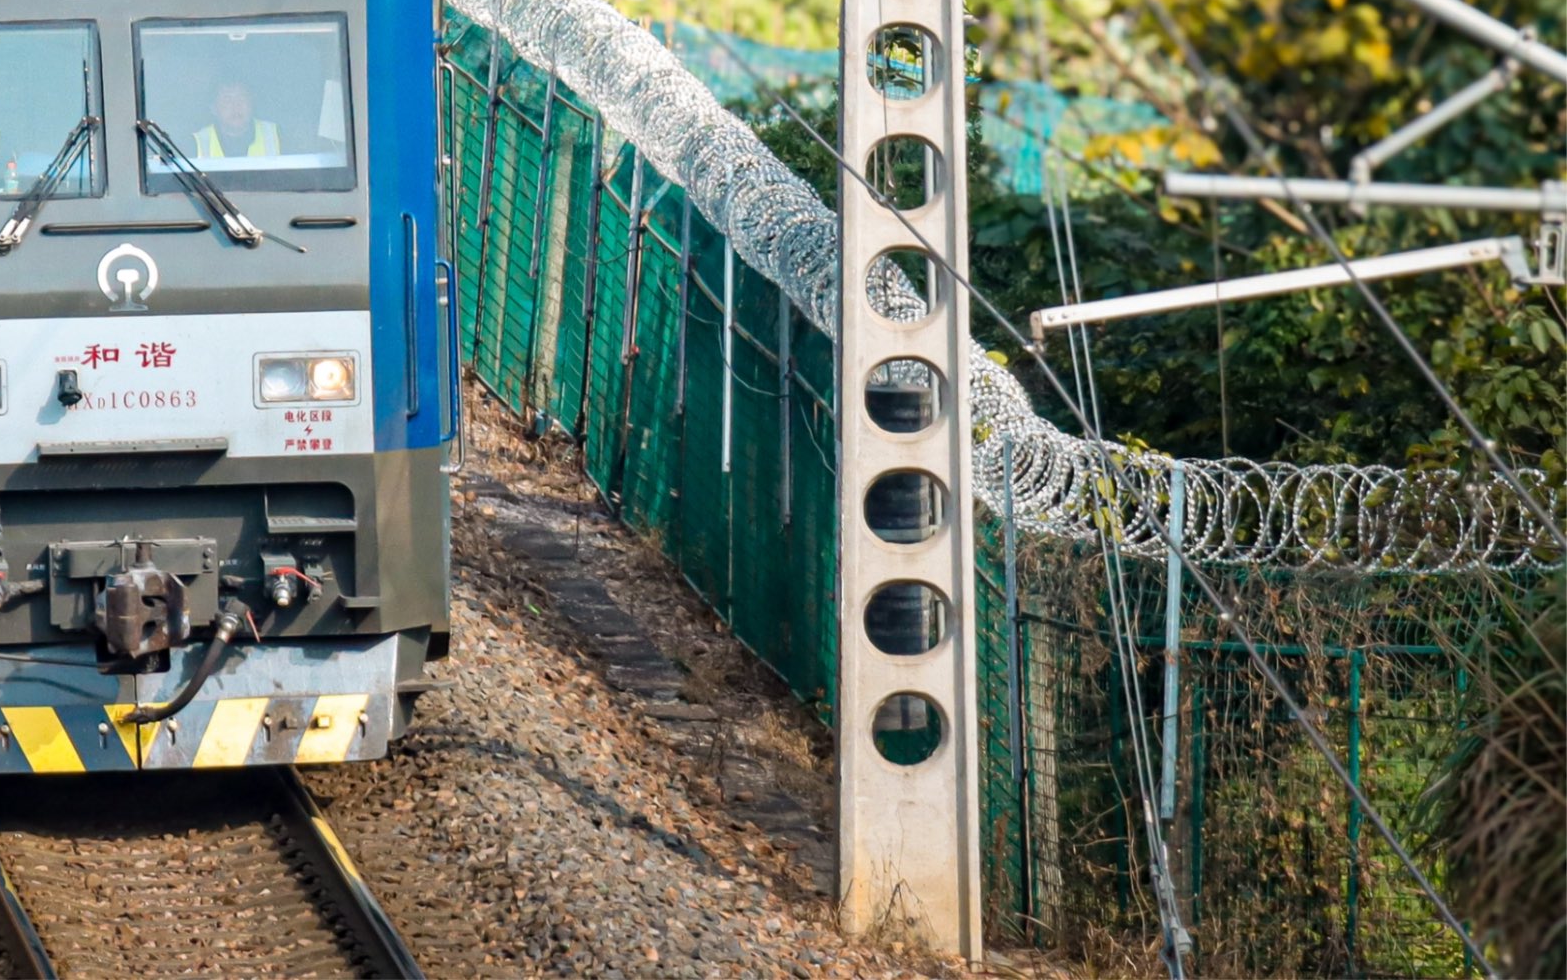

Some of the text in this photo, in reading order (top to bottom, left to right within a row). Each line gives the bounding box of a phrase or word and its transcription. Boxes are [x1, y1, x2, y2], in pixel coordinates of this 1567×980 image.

[81, 341, 177, 370] 和谐
[284, 409, 332, 422] 电化区段
